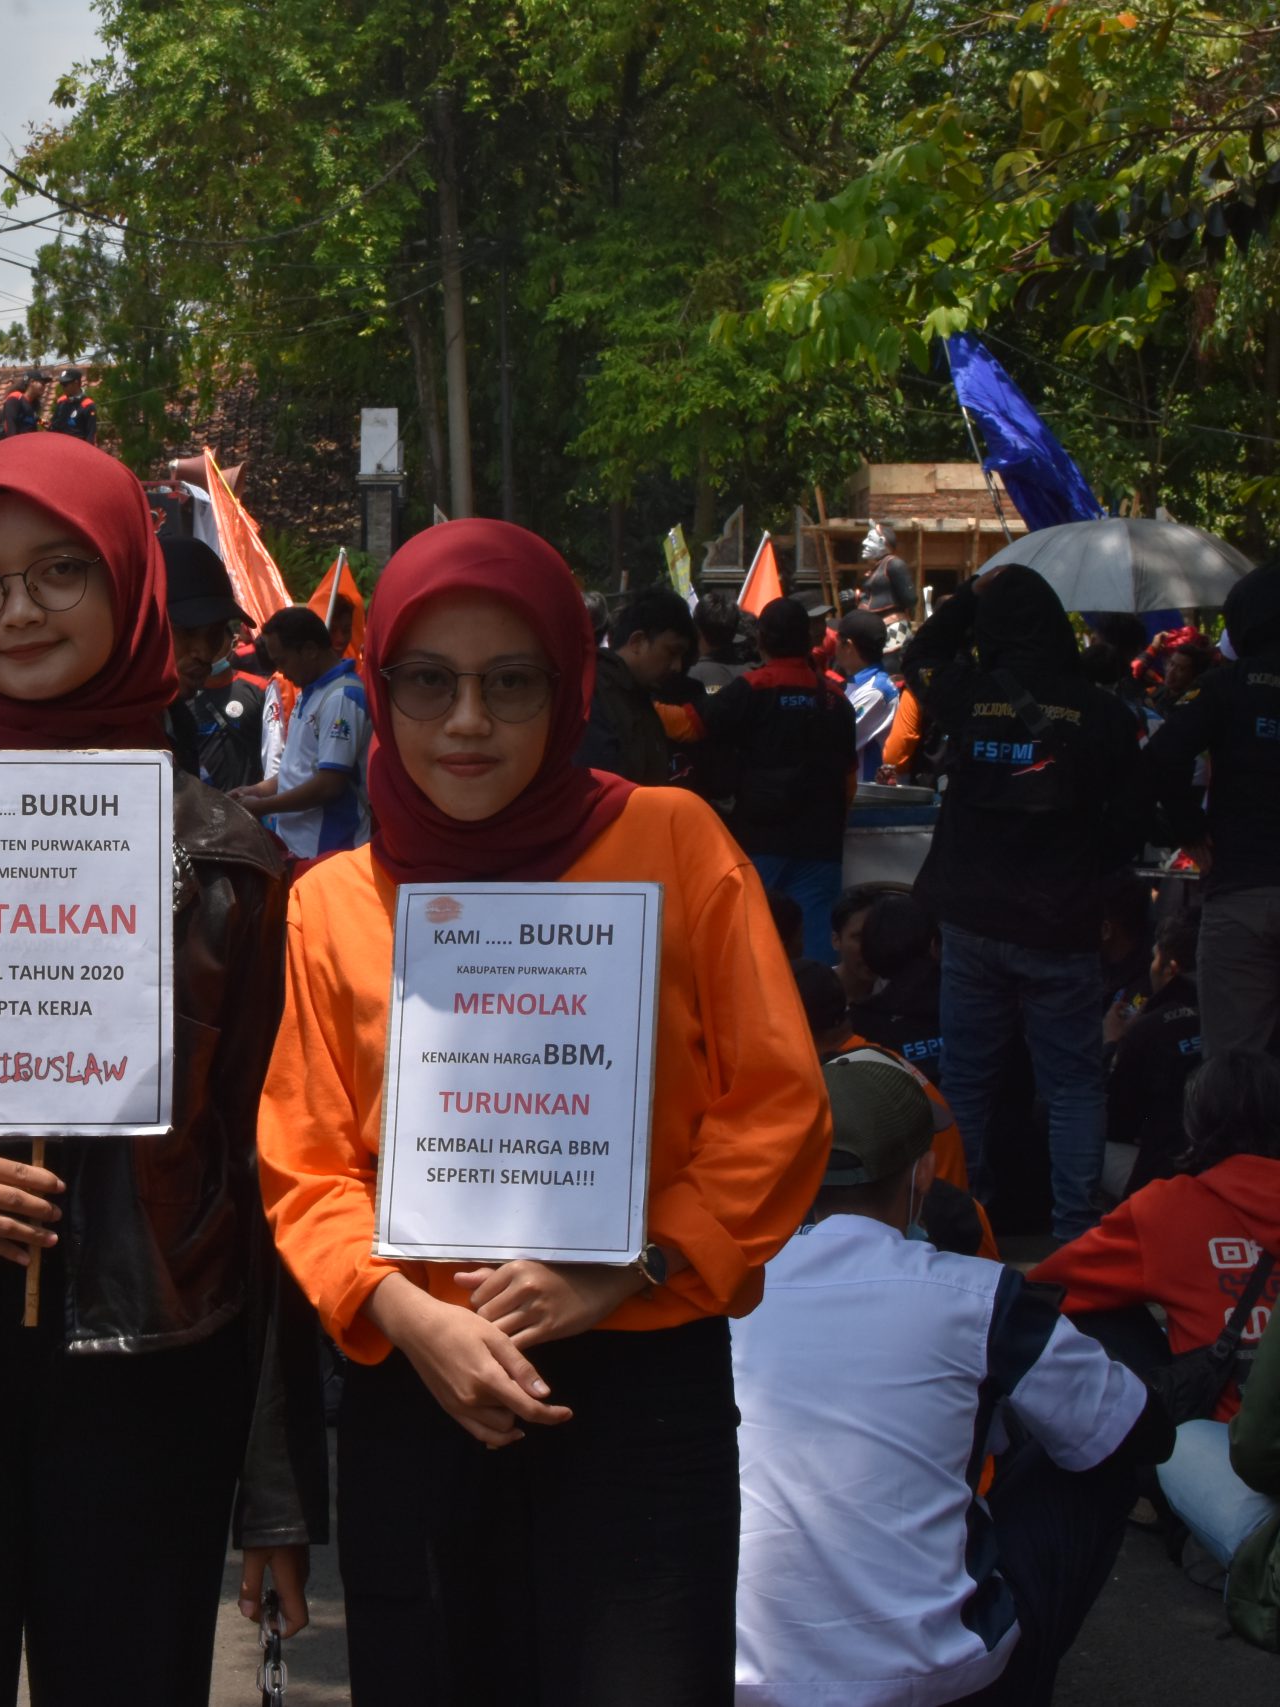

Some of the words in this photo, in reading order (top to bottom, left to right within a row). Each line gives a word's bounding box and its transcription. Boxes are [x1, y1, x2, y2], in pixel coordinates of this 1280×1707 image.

[973, 741, 1034, 760] FSPMI
[22, 794, 118, 816] BURUH
[32, 840, 130, 851] PURWAKARTA
[434, 930, 480, 944] KAMI
[520, 924, 613, 945] BURUH
[8, 965, 74, 980] TAHUN
[81, 965, 124, 980] 2020
[457, 966, 515, 974] KABUPATEN
[518, 966, 587, 975] PURWAKARTA
[39, 1001, 92, 1015] KERJA
[454, 993, 587, 1015] MENOLAK
[422, 1052, 489, 1064] KENAIKAN
[494, 1053, 541, 1064] HARGA
[544, 1044, 612, 1070] BBM,
[439, 1092, 590, 1115] TURUNKAN
[417, 1138, 493, 1153] KEMBALI
[500, 1139, 562, 1155] HARGA
[569, 1141, 609, 1155] BBM
[427, 1168, 494, 1183] SEPERTI
[501, 1169, 594, 1186] SEMULA!!!
